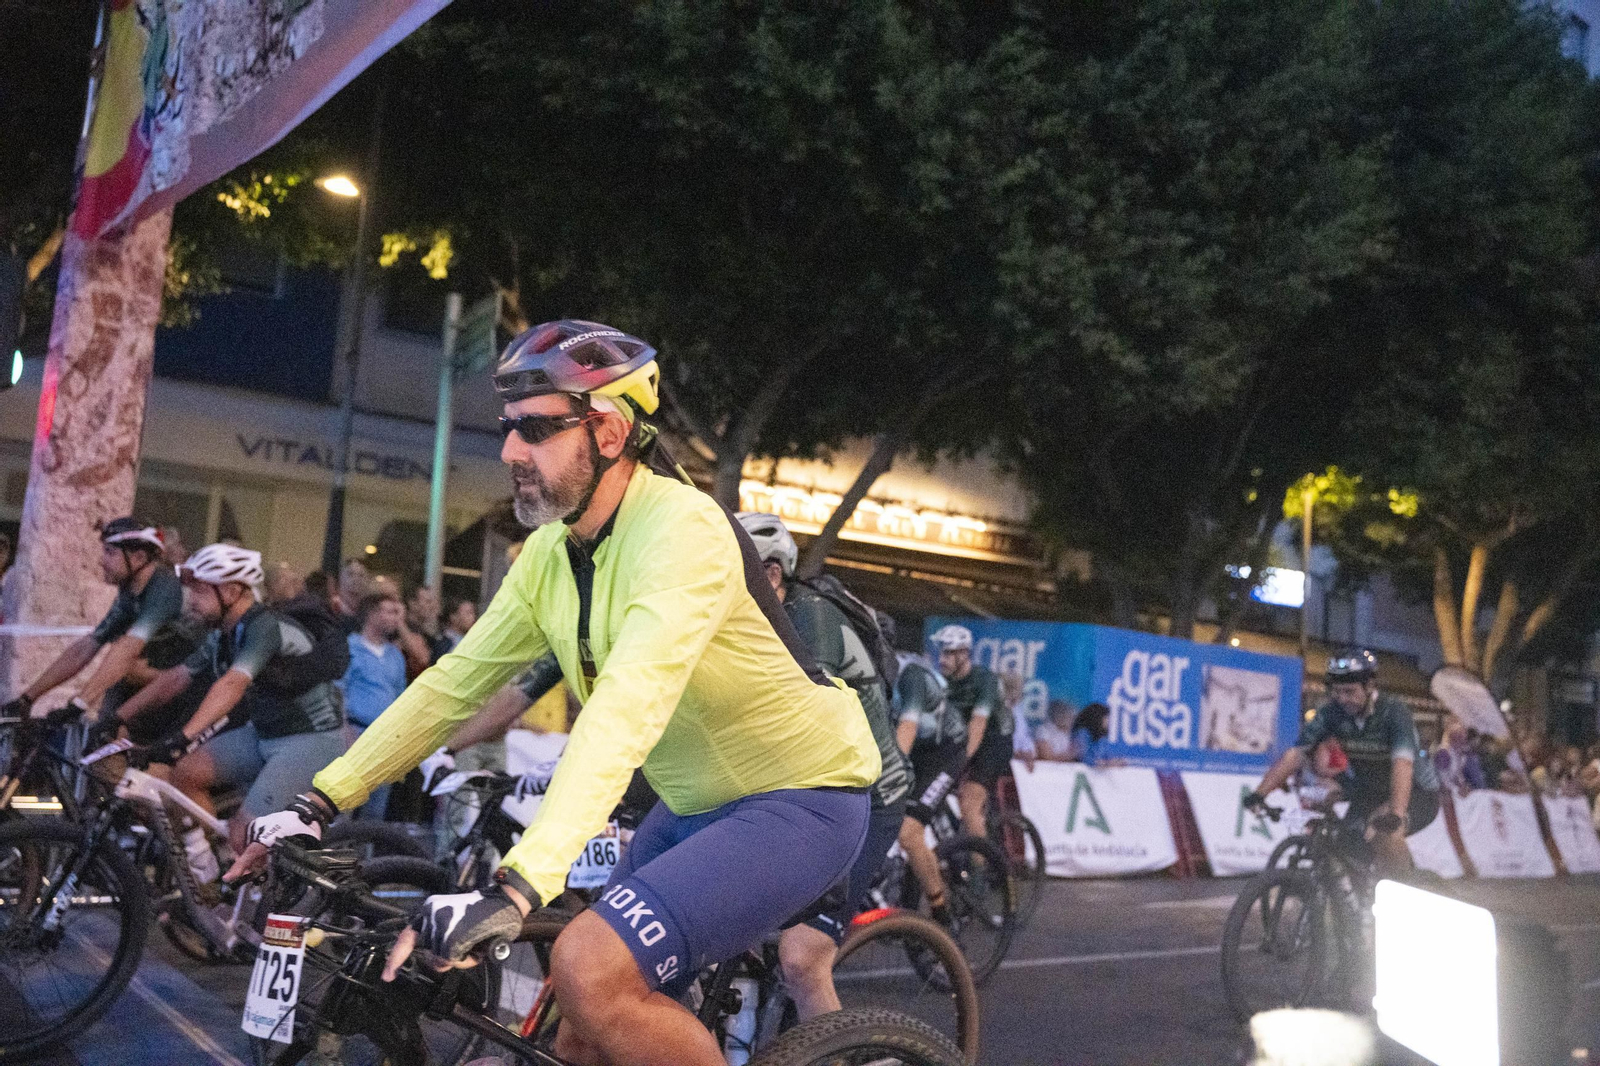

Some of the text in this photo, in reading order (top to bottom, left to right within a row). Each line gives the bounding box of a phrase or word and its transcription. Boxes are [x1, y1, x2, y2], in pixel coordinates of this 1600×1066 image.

[558, 330, 625, 351] ROCKRIDER
[236, 433, 458, 482] VITALDEN
[1122, 650, 1190, 715] gar
[1106, 677, 1193, 750] fusa
